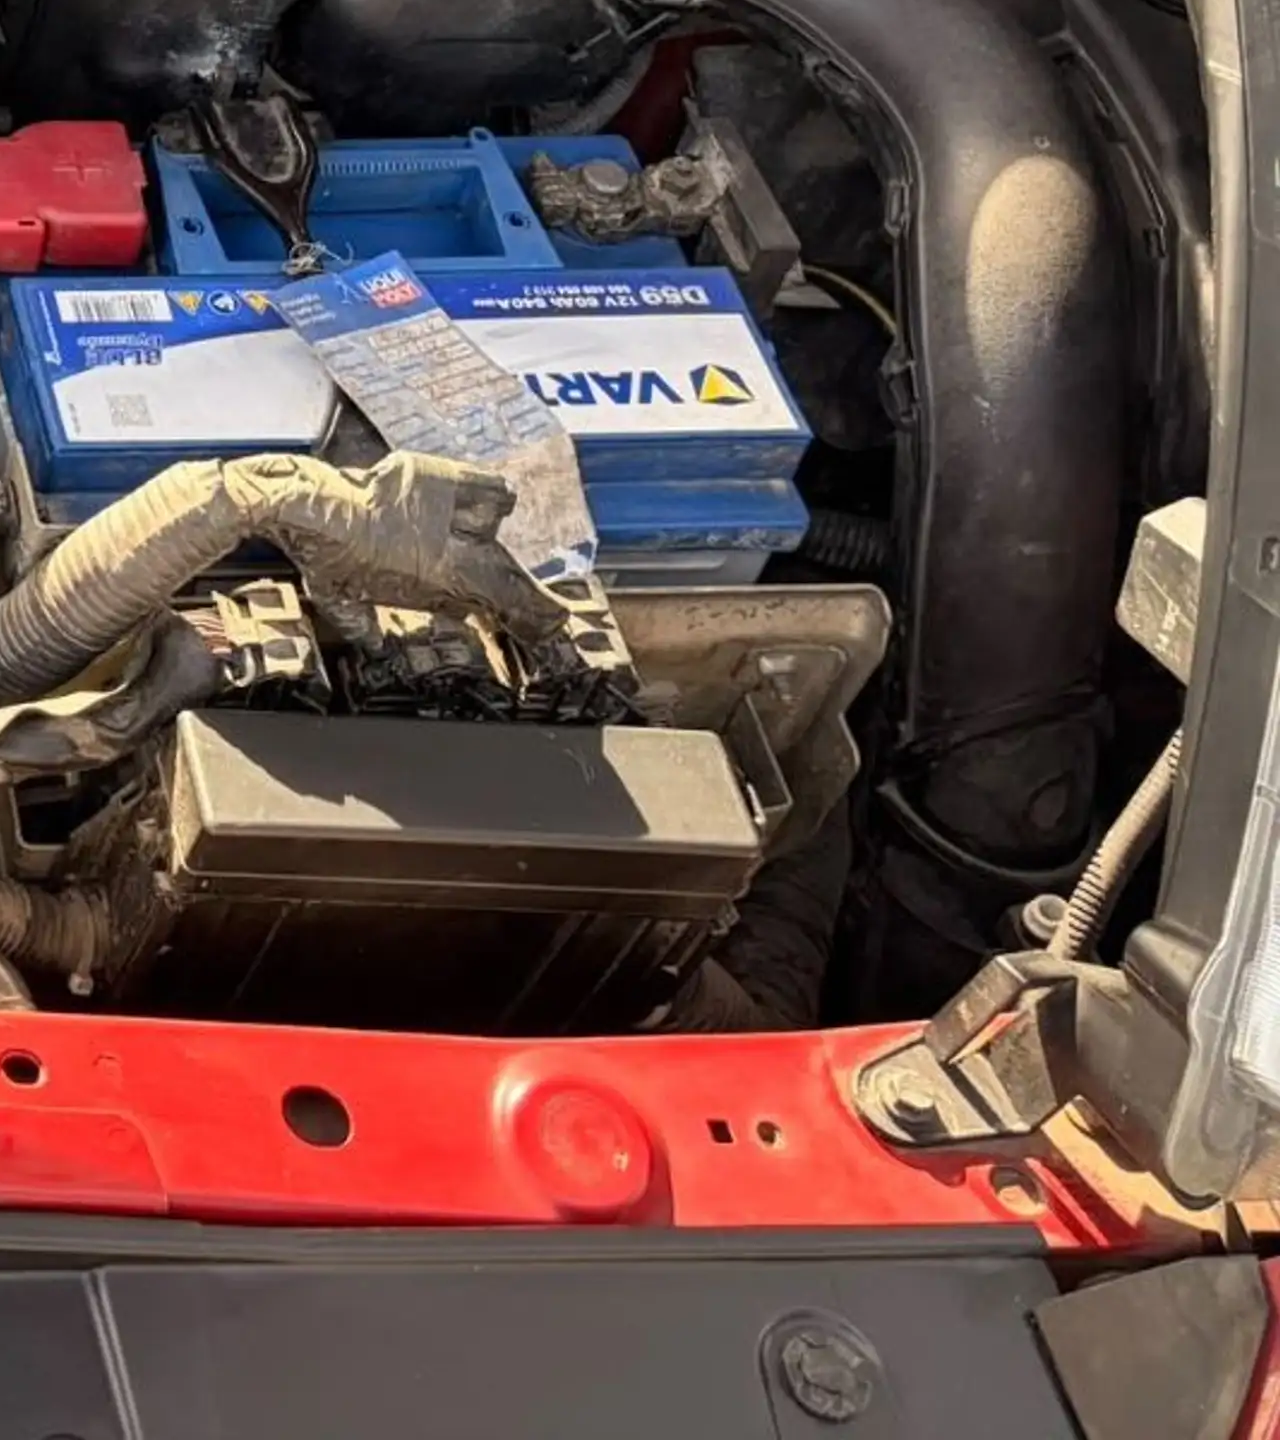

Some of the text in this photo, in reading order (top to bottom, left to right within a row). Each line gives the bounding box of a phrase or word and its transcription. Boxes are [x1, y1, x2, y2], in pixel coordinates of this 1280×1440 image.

[604, 295, 639, 309] 12V
[640, 284, 712, 307] D59
[523, 370, 685, 407] VART
